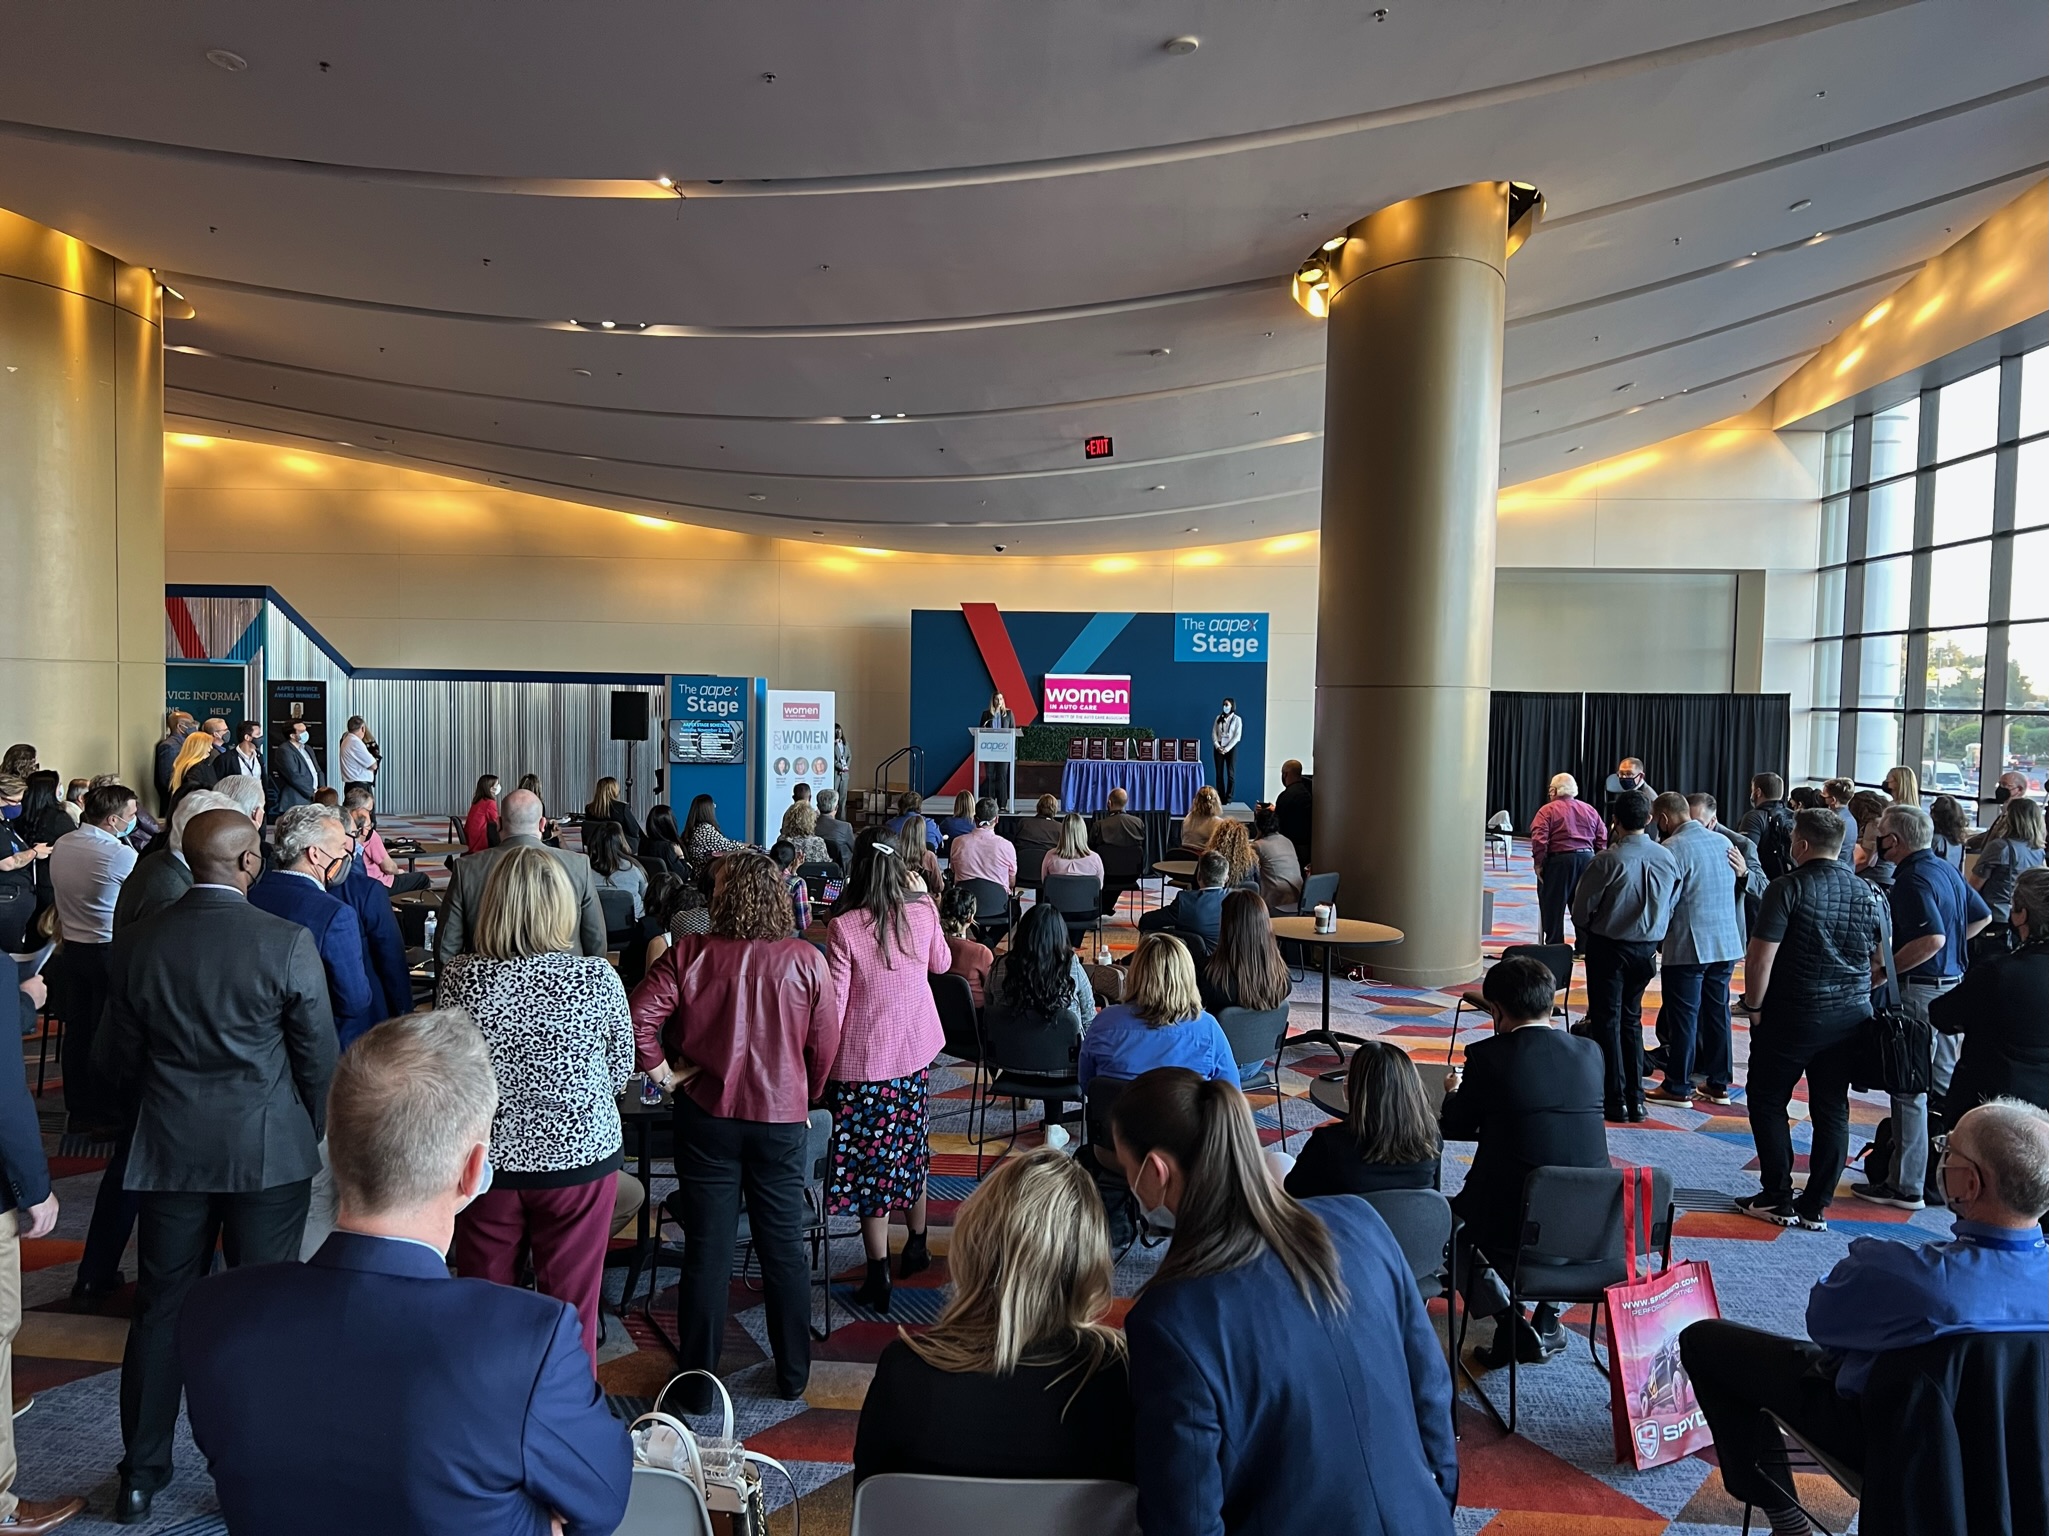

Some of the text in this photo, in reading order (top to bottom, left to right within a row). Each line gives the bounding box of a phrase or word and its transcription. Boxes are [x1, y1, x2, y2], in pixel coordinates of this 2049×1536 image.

[1090, 438, 1109, 455] EXIT
[1182, 617, 1259, 636] The aapex
[1192, 632, 1259, 658] Stage
[166, 690, 191, 700] VICE
[679, 683, 697, 694] The
[1045, 688, 1128, 704] women
[210, 707, 232, 716] HELP
[687, 696, 739, 717] Stage
[784, 707, 819, 715] women
[782, 730, 828, 744] WOMEN
[980, 741, 1009, 751] aapex
